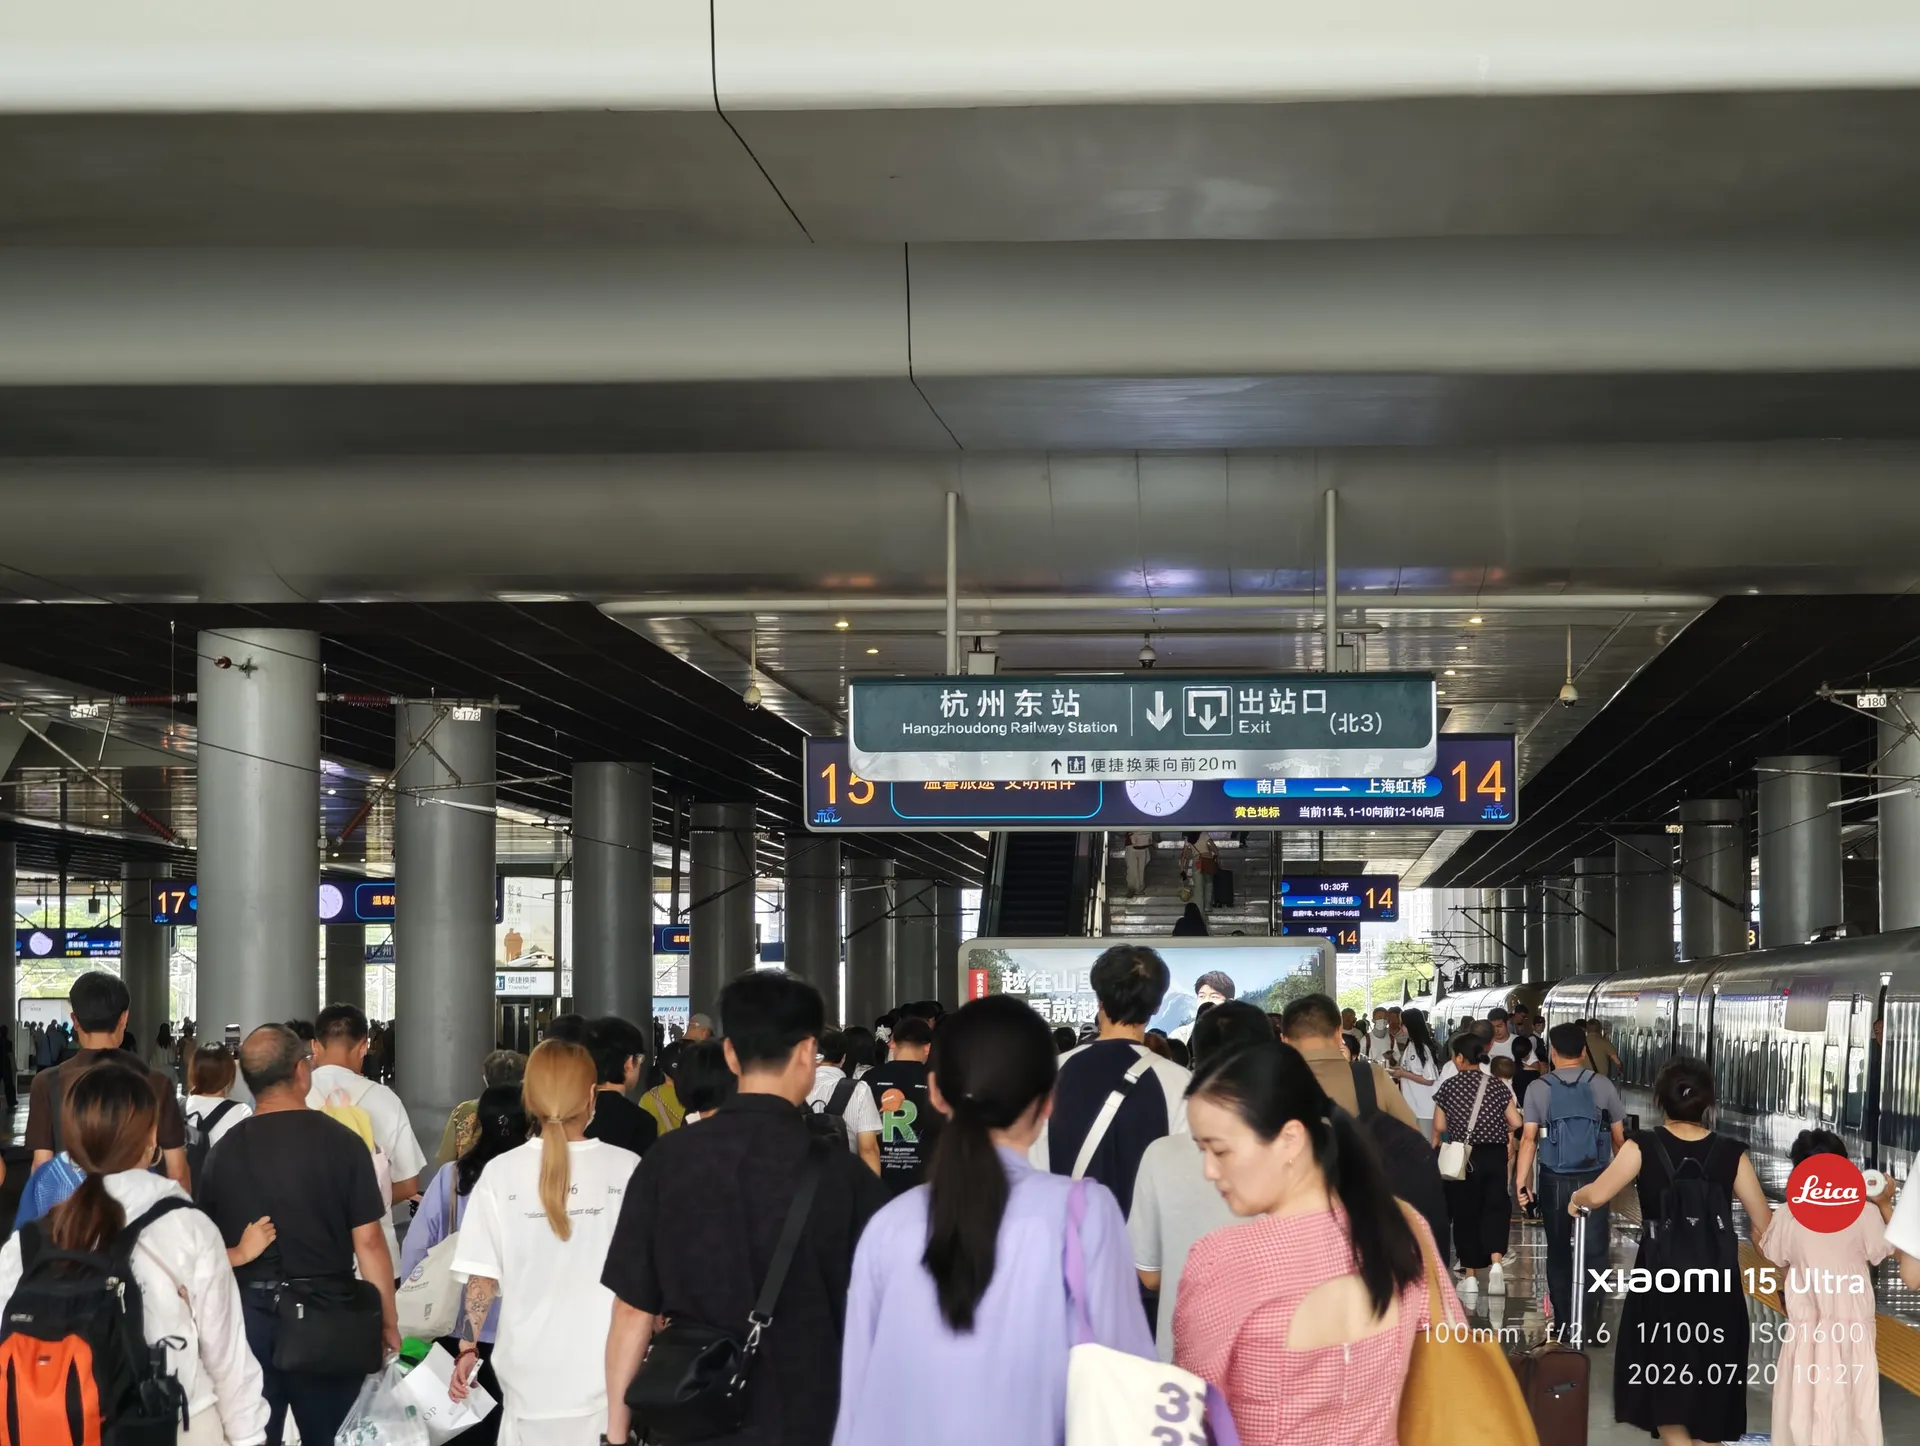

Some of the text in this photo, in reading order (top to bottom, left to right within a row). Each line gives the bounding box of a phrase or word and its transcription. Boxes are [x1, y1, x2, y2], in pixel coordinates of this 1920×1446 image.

[940, 689, 1080, 717] 杭州东站
[1239, 688, 1327, 715] 出站口
[902, 721, 1118, 736] Hangzhoudong Railway Station
[1239, 719, 1271, 734] Exit
[1329, 712, 1383, 735] (北3)
[821, 762, 875, 805] 15
[1256, 778, 1427, 795] 南昌 上海虹桥
[1452, 760, 1506, 803] 14
[1234, 806, 1280, 818] 黄色地标
[1319, 882, 1349, 892] 10:30开
[1365, 887, 1393, 909] 14
[158, 891, 186, 914] 17
[1323, 896, 1354, 905] 上海虹桥
[1338, 930, 1358, 945] 14
[882, 1099, 920, 1143] R
